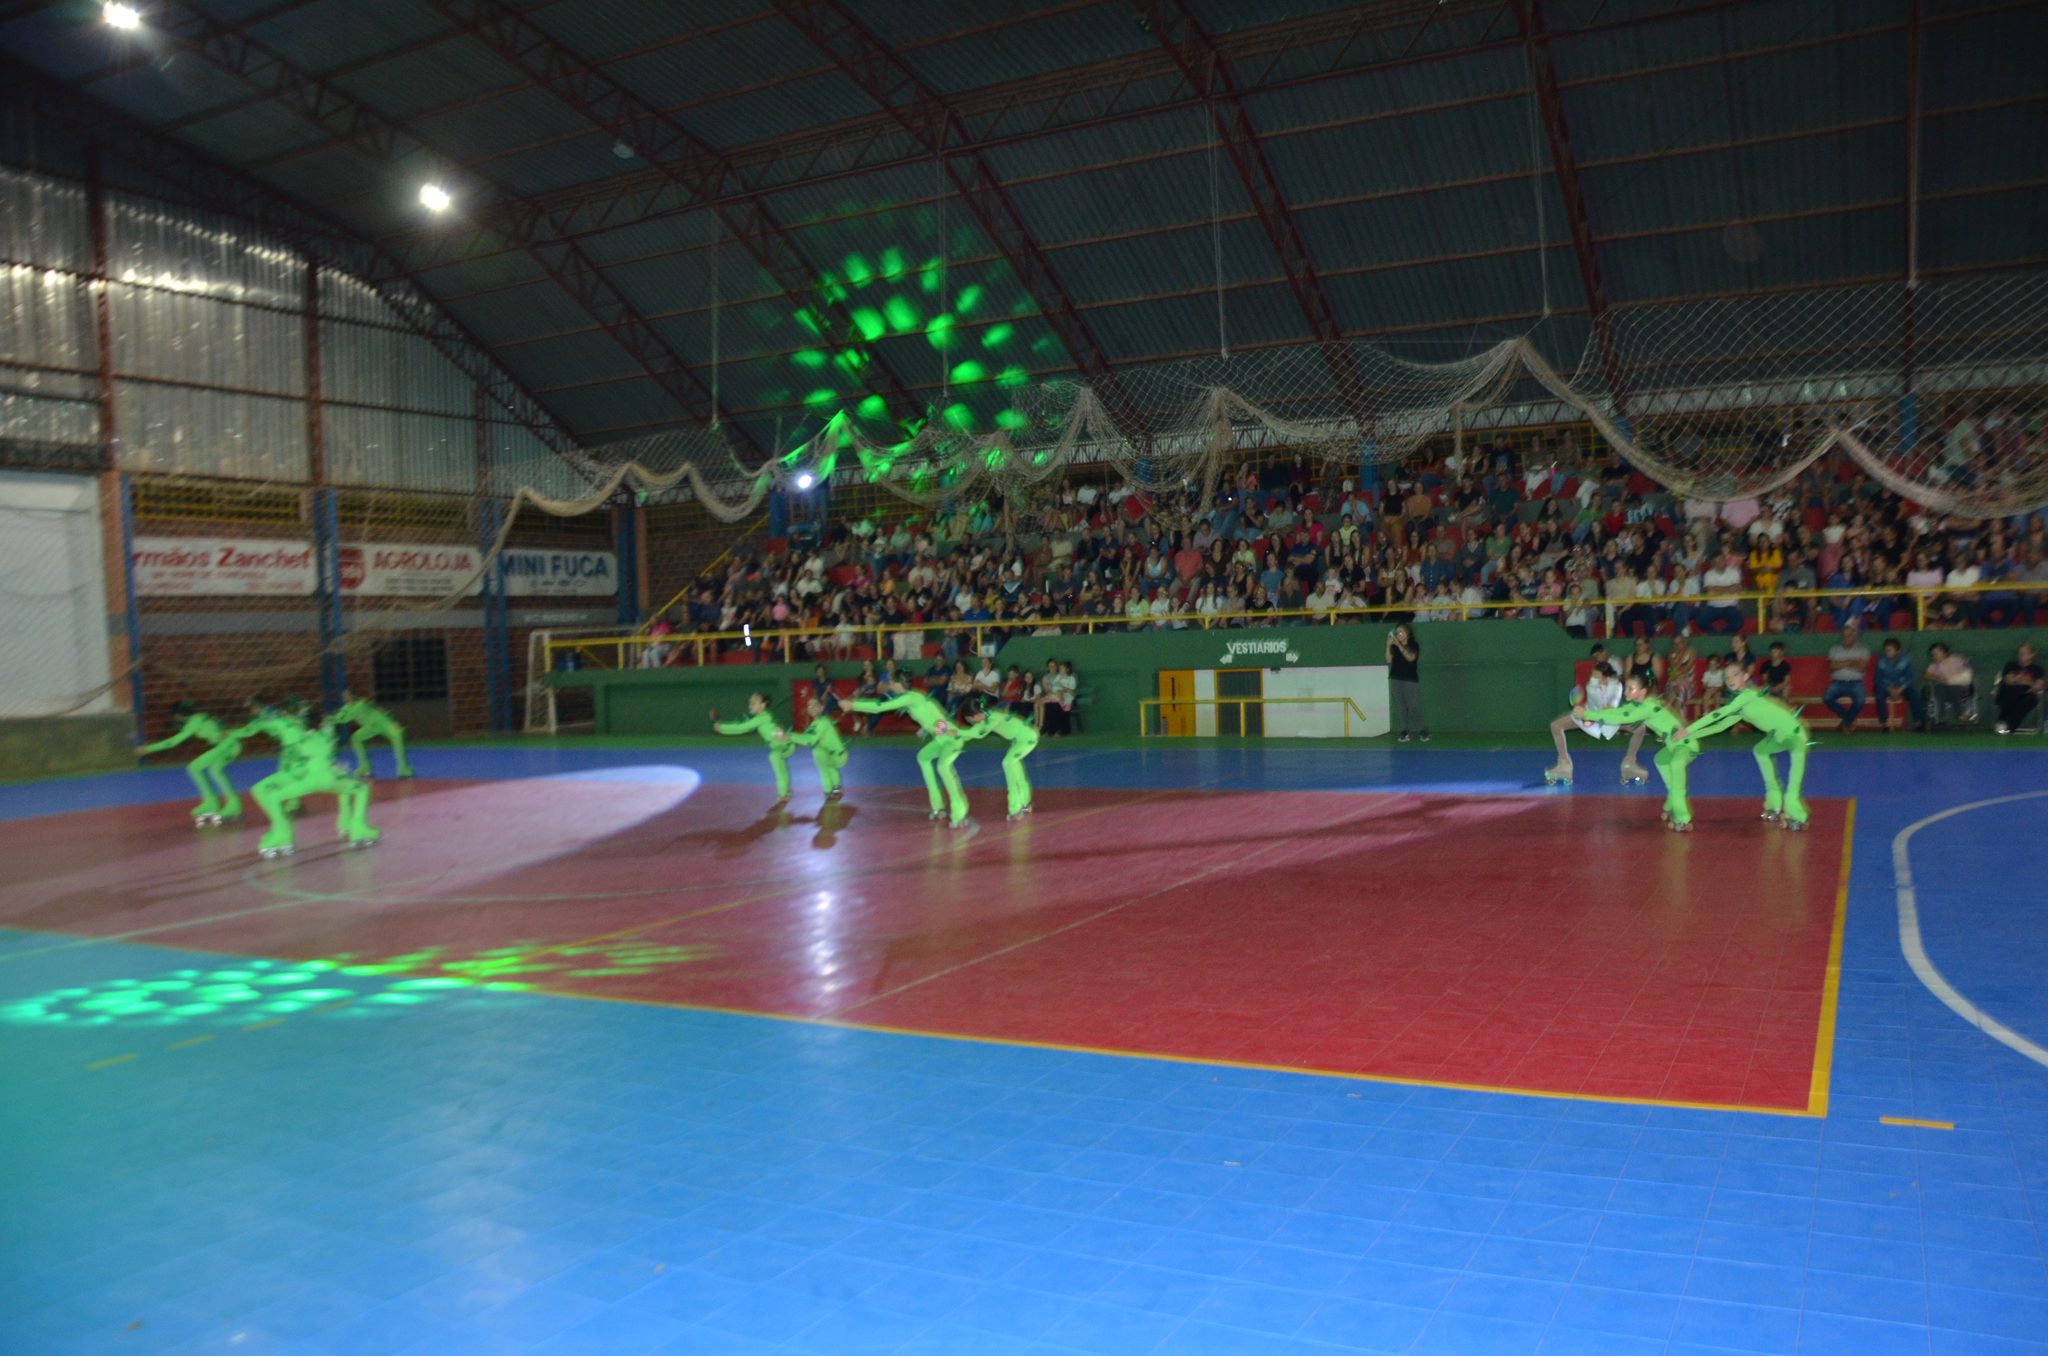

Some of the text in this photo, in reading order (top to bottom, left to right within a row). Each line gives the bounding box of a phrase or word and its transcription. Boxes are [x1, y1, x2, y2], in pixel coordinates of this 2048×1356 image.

[132, 547, 211, 567] rmãos
[373, 551, 472, 570] AGROLOJA
[551, 555, 608, 577] FUCA
[1226, 641, 1287, 655] VESTIARIOS
